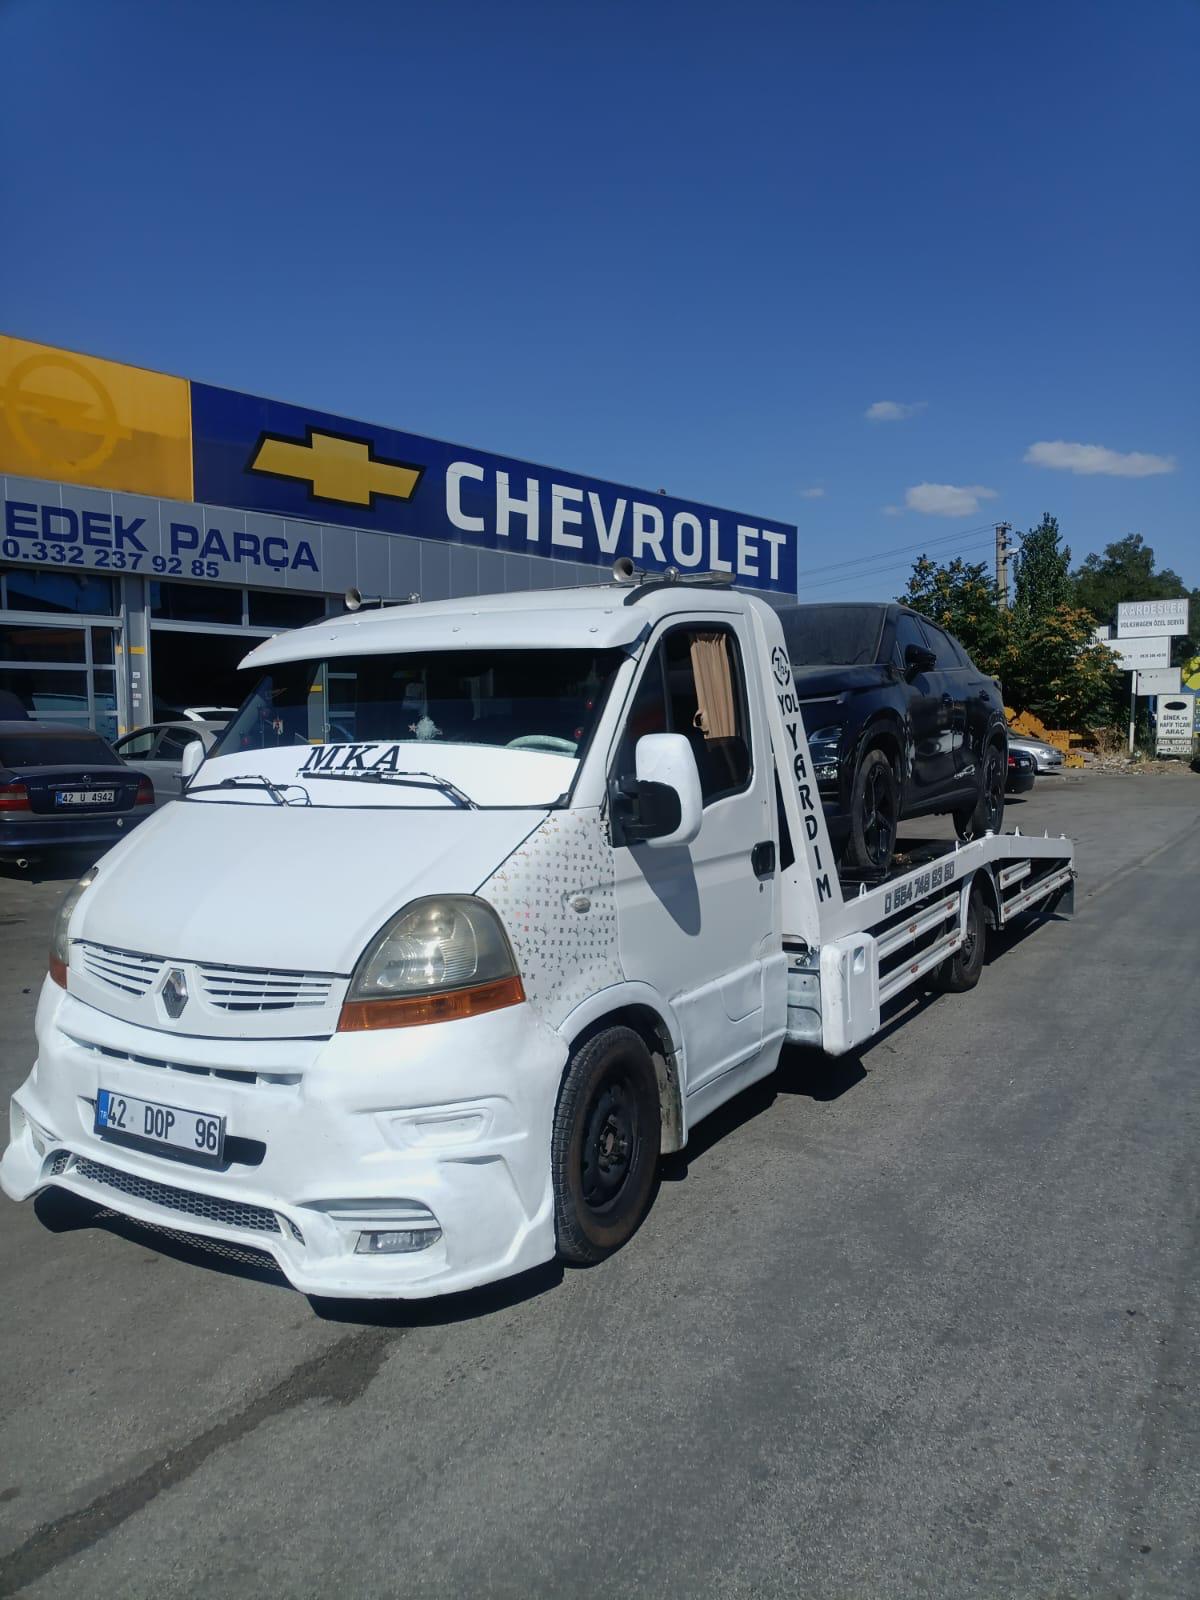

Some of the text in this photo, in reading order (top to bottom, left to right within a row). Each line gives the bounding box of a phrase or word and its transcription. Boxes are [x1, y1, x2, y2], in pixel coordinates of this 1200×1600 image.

[5, 501, 319, 573] EDEK PARÇA
[446, 461, 787, 580] CHEVROLET
[2, 538, 219, 578] 0.332 237 92 85
[298, 745, 401, 772] MKA
[62, 791, 113, 803] 42 U 4942
[777, 693, 832, 902] YOL YARDIM
[108, 1096, 218, 1150] 42 DOP 96
